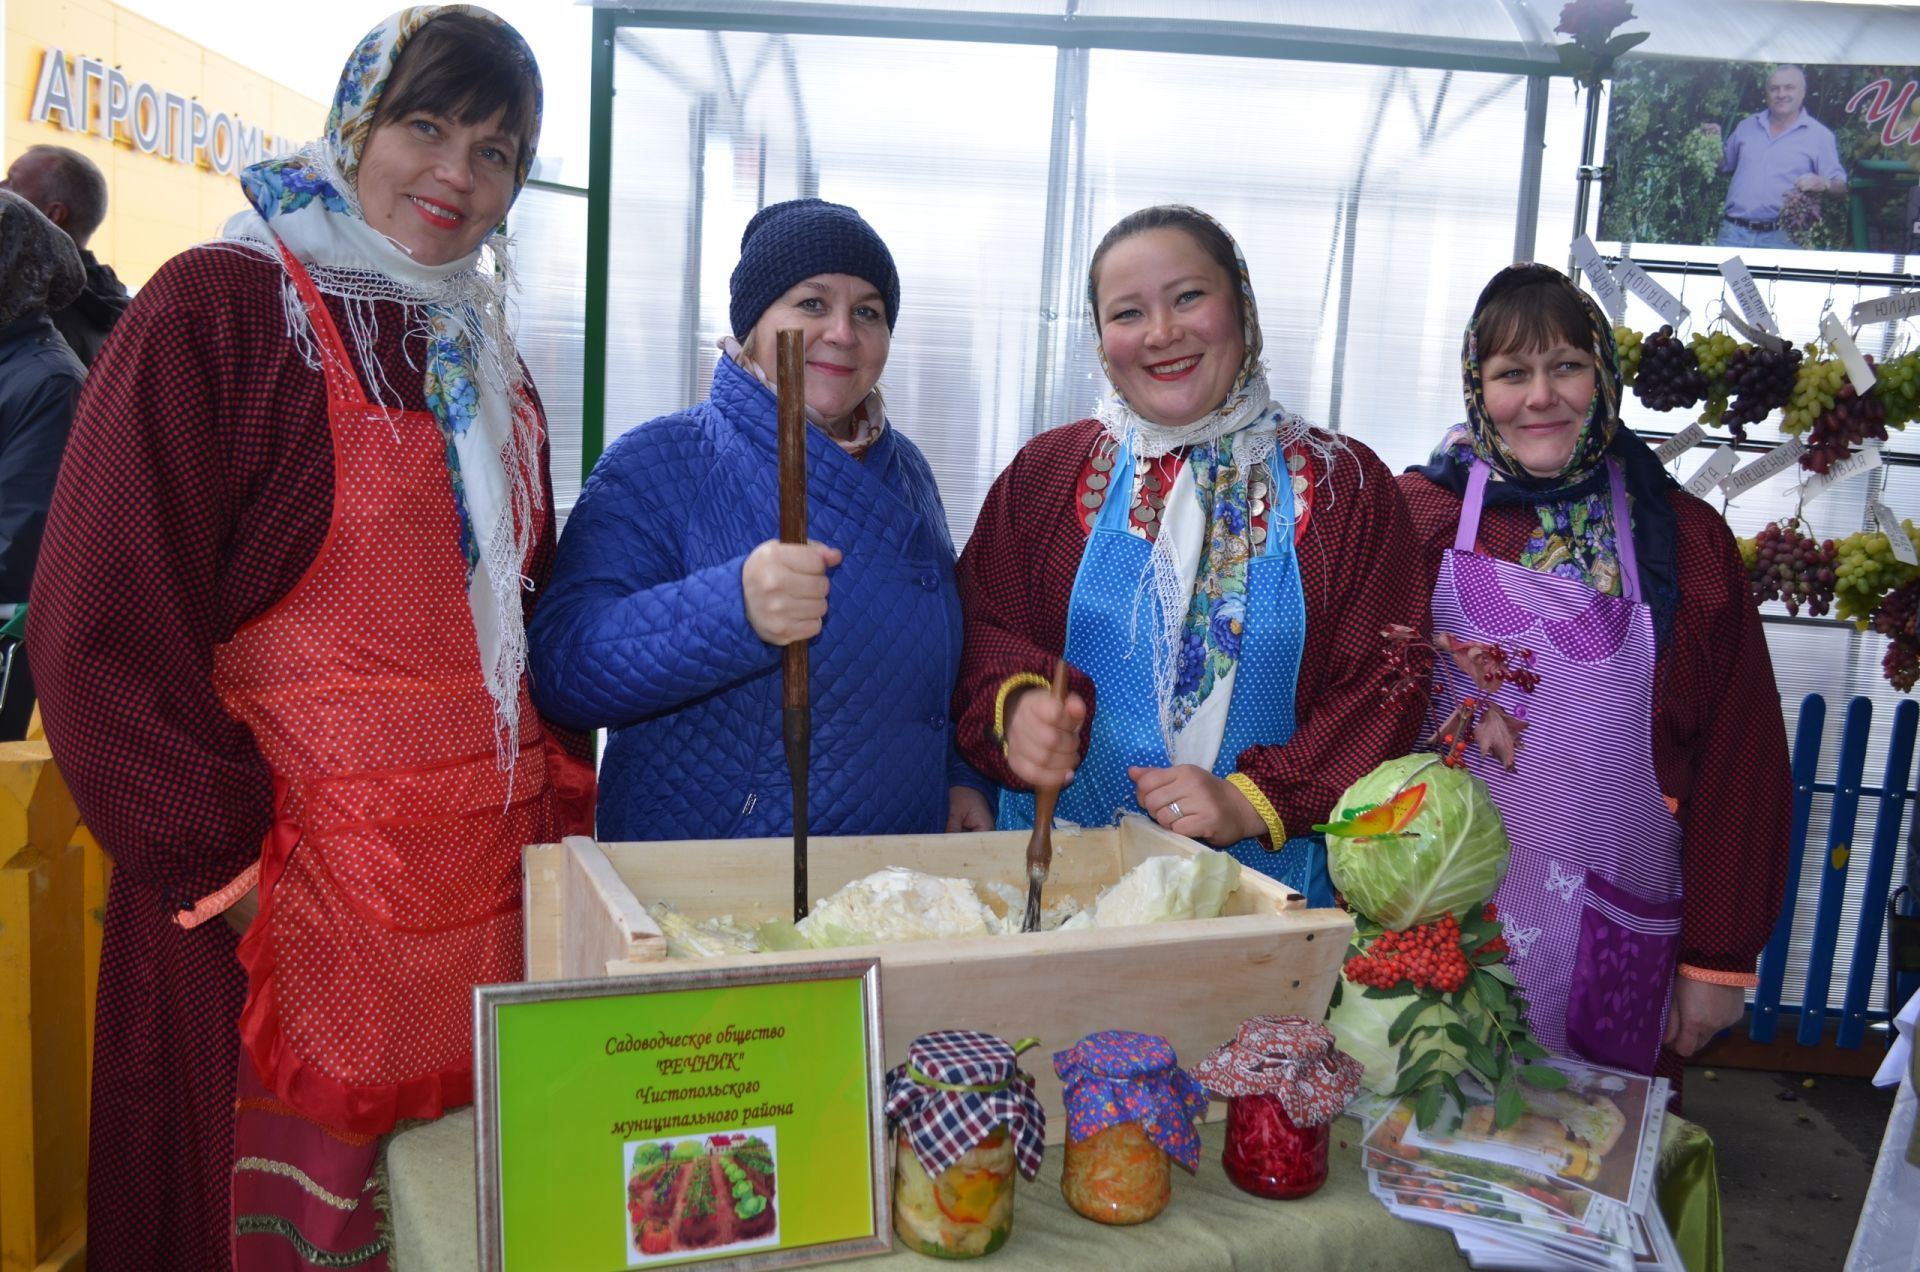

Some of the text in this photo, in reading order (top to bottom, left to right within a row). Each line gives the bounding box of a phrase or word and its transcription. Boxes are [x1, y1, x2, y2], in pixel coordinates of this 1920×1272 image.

[1845, 79, 1920, 146] Ч
[1622, 268, 1671, 312] ЭТАЛОН
[1732, 280, 1755, 319] ПАМЯТЬ
[1741, 274, 1768, 319] УЧИТЕЛЯ
[1874, 296, 1920, 317] ЮЛИА
[605, 1024, 785, 1055] Садоводческое общество
[656, 1052, 745, 1076] "РЕЧНИК"
[635, 1080, 760, 1104] Чистопольского
[611, 1101, 794, 1139] муниципального района
